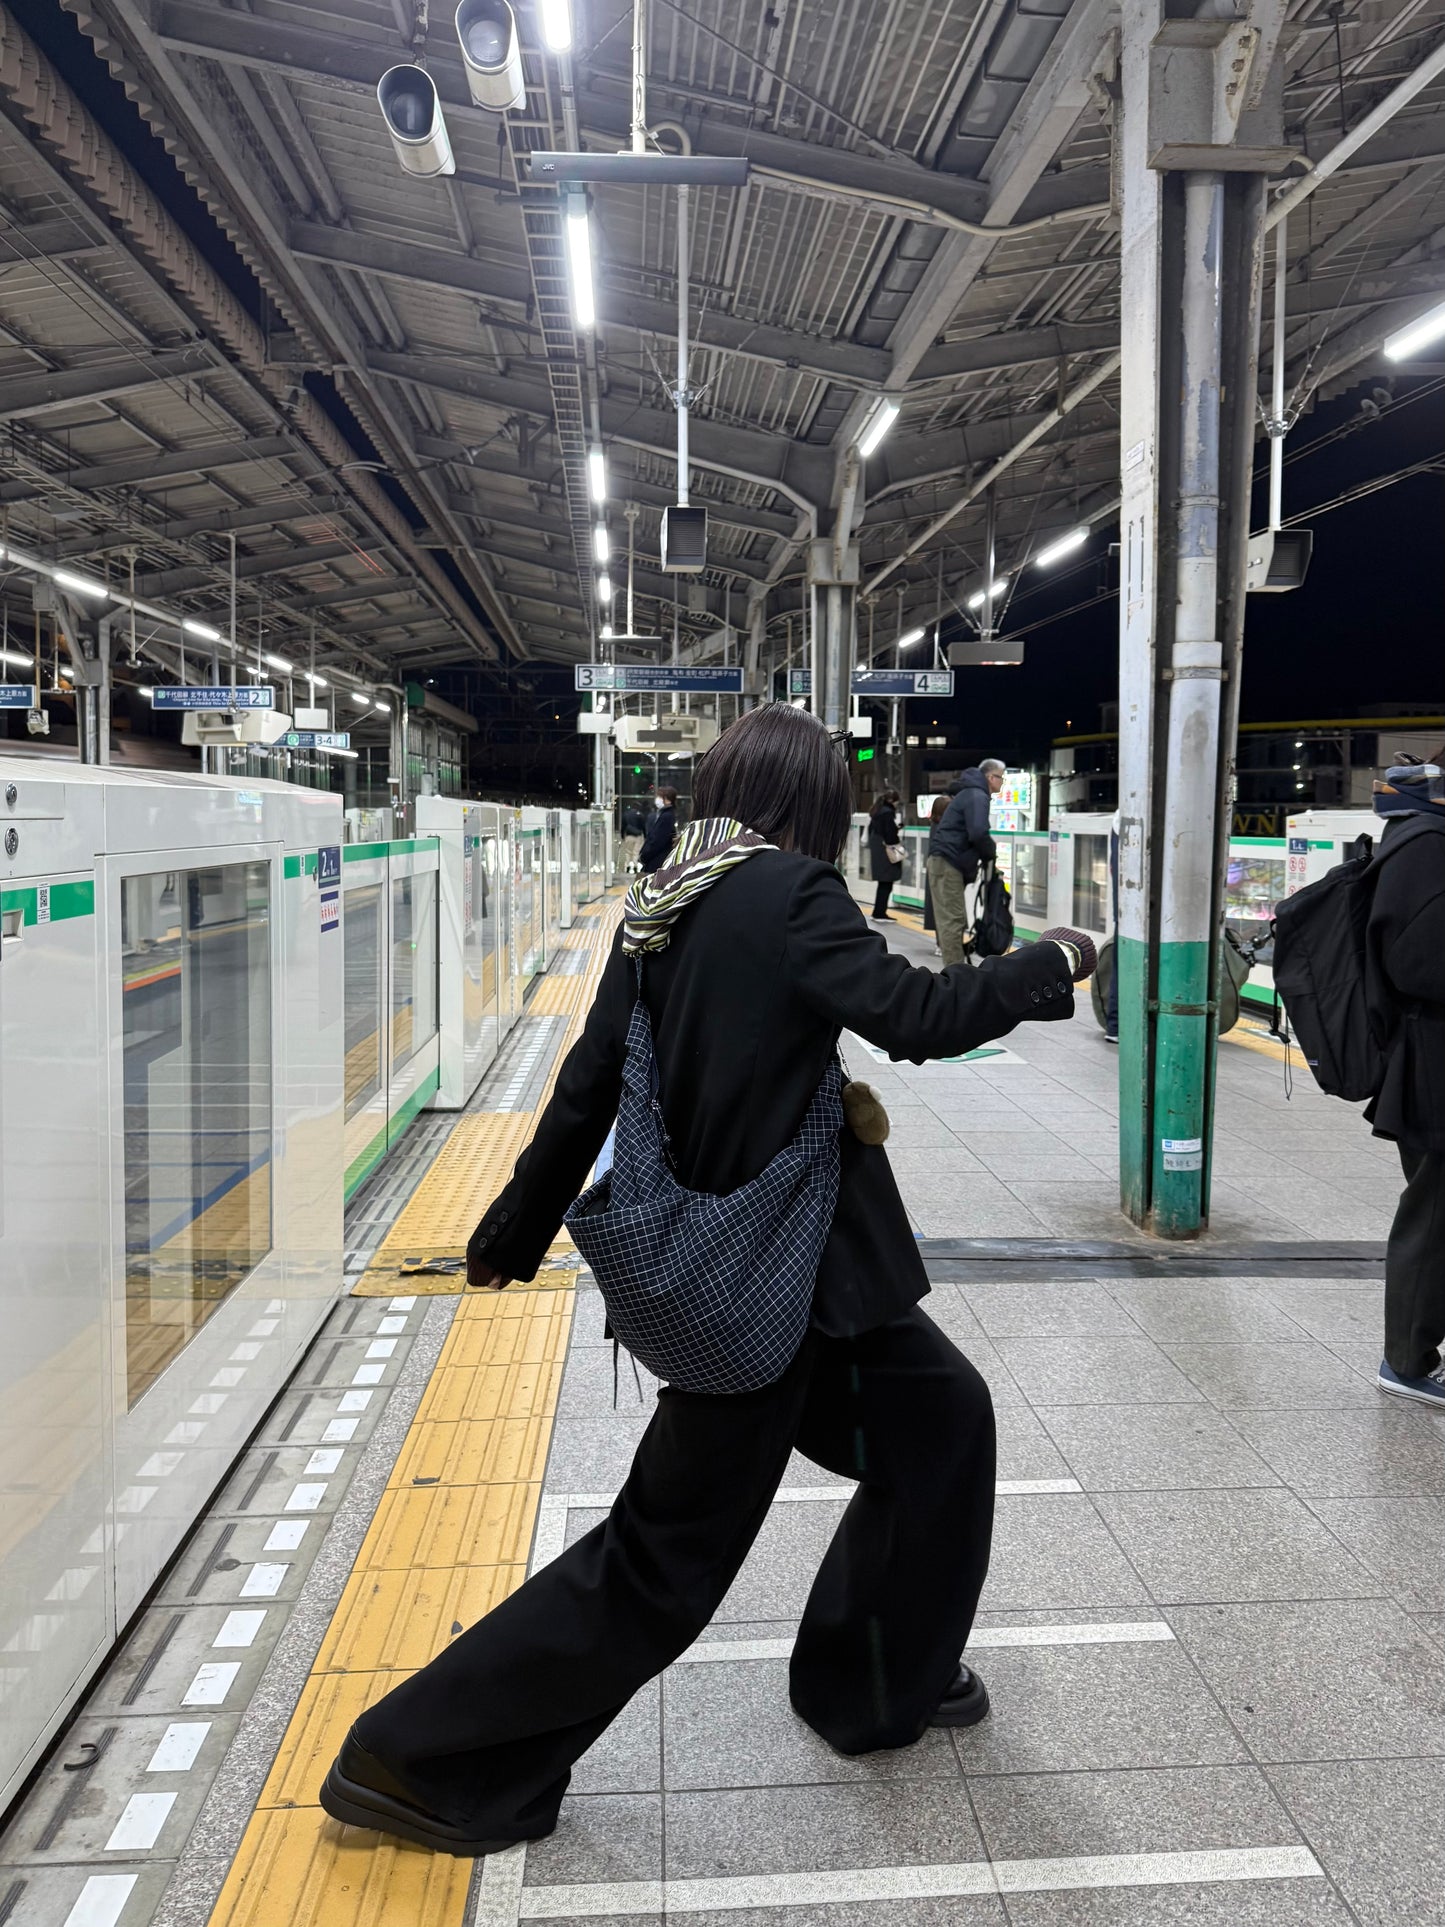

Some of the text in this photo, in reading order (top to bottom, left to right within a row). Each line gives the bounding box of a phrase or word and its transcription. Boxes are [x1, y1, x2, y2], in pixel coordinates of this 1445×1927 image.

[582, 668, 593, 686] 3
[917, 674, 930, 692] 4
[251, 692, 260, 704] 2
